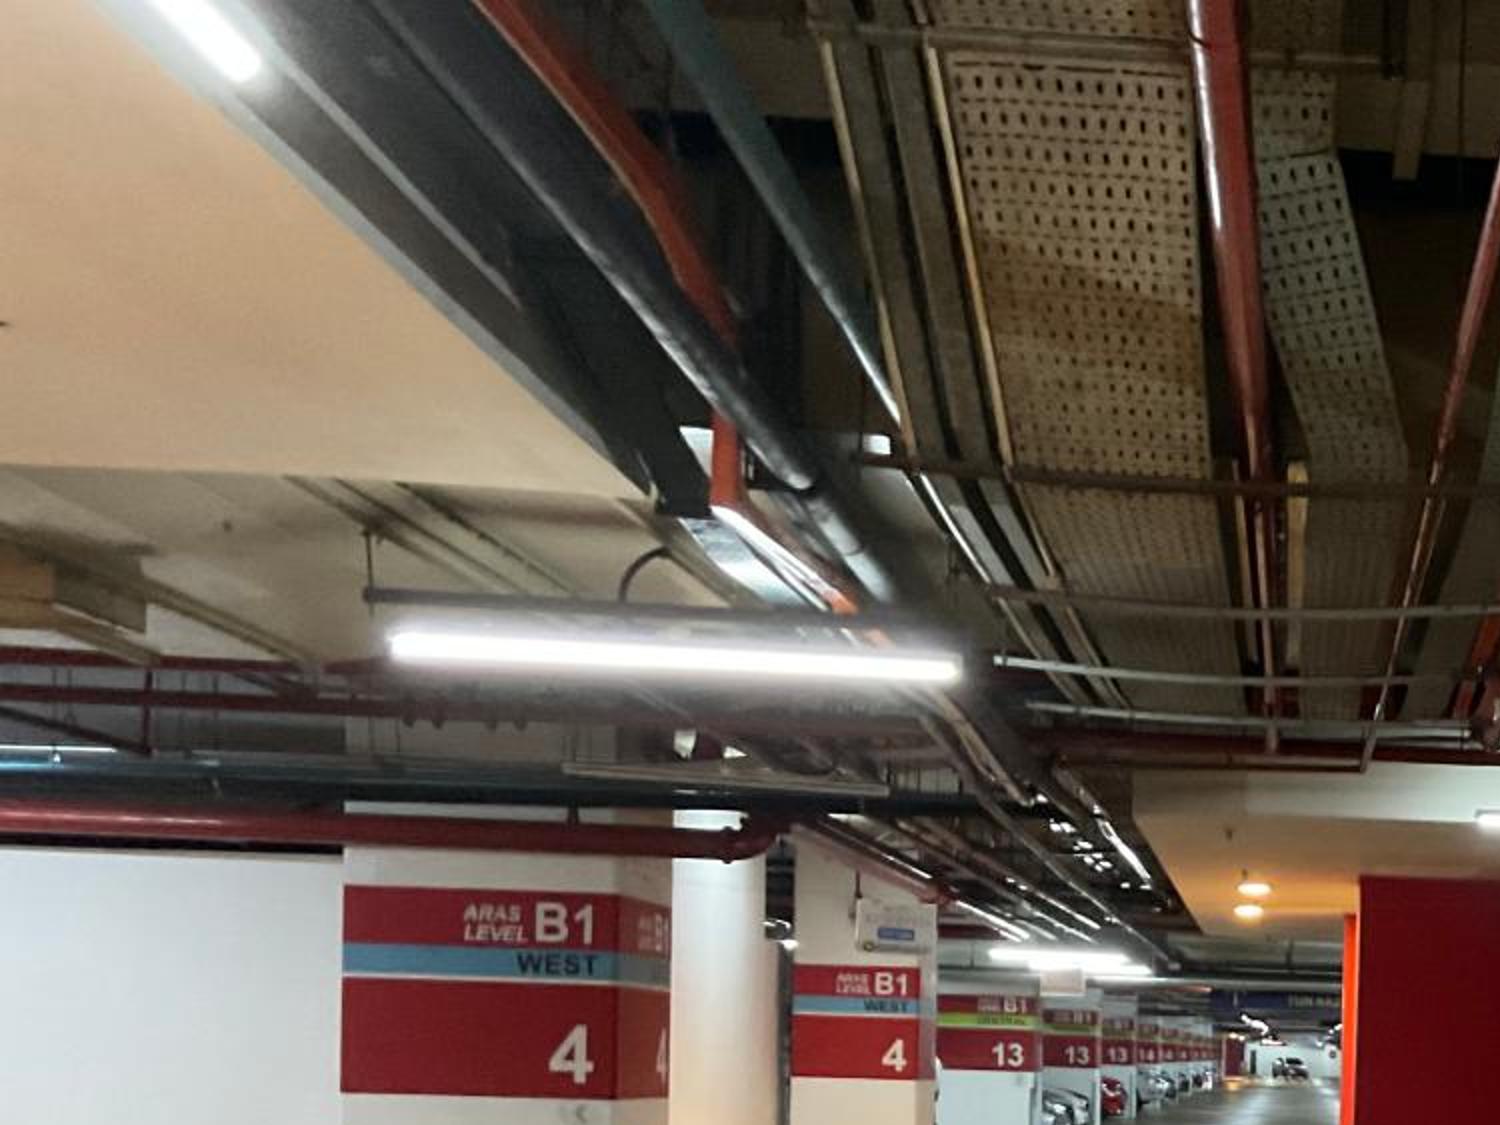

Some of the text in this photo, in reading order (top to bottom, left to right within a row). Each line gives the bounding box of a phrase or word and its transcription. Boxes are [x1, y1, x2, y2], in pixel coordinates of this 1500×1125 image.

[463, 903, 521, 922] ARAS
[535, 902, 594, 945] B1
[464, 925, 528, 942] LEVEL
[516, 952, 601, 977] WEST
[875, 972, 908, 996] B1
[863, 999, 908, 1013] WEST
[548, 1023, 595, 1085] 4
[881, 1037, 908, 1073] 4
[991, 1041, 1025, 1067] 13
[1064, 1045, 1090, 1065] 13
